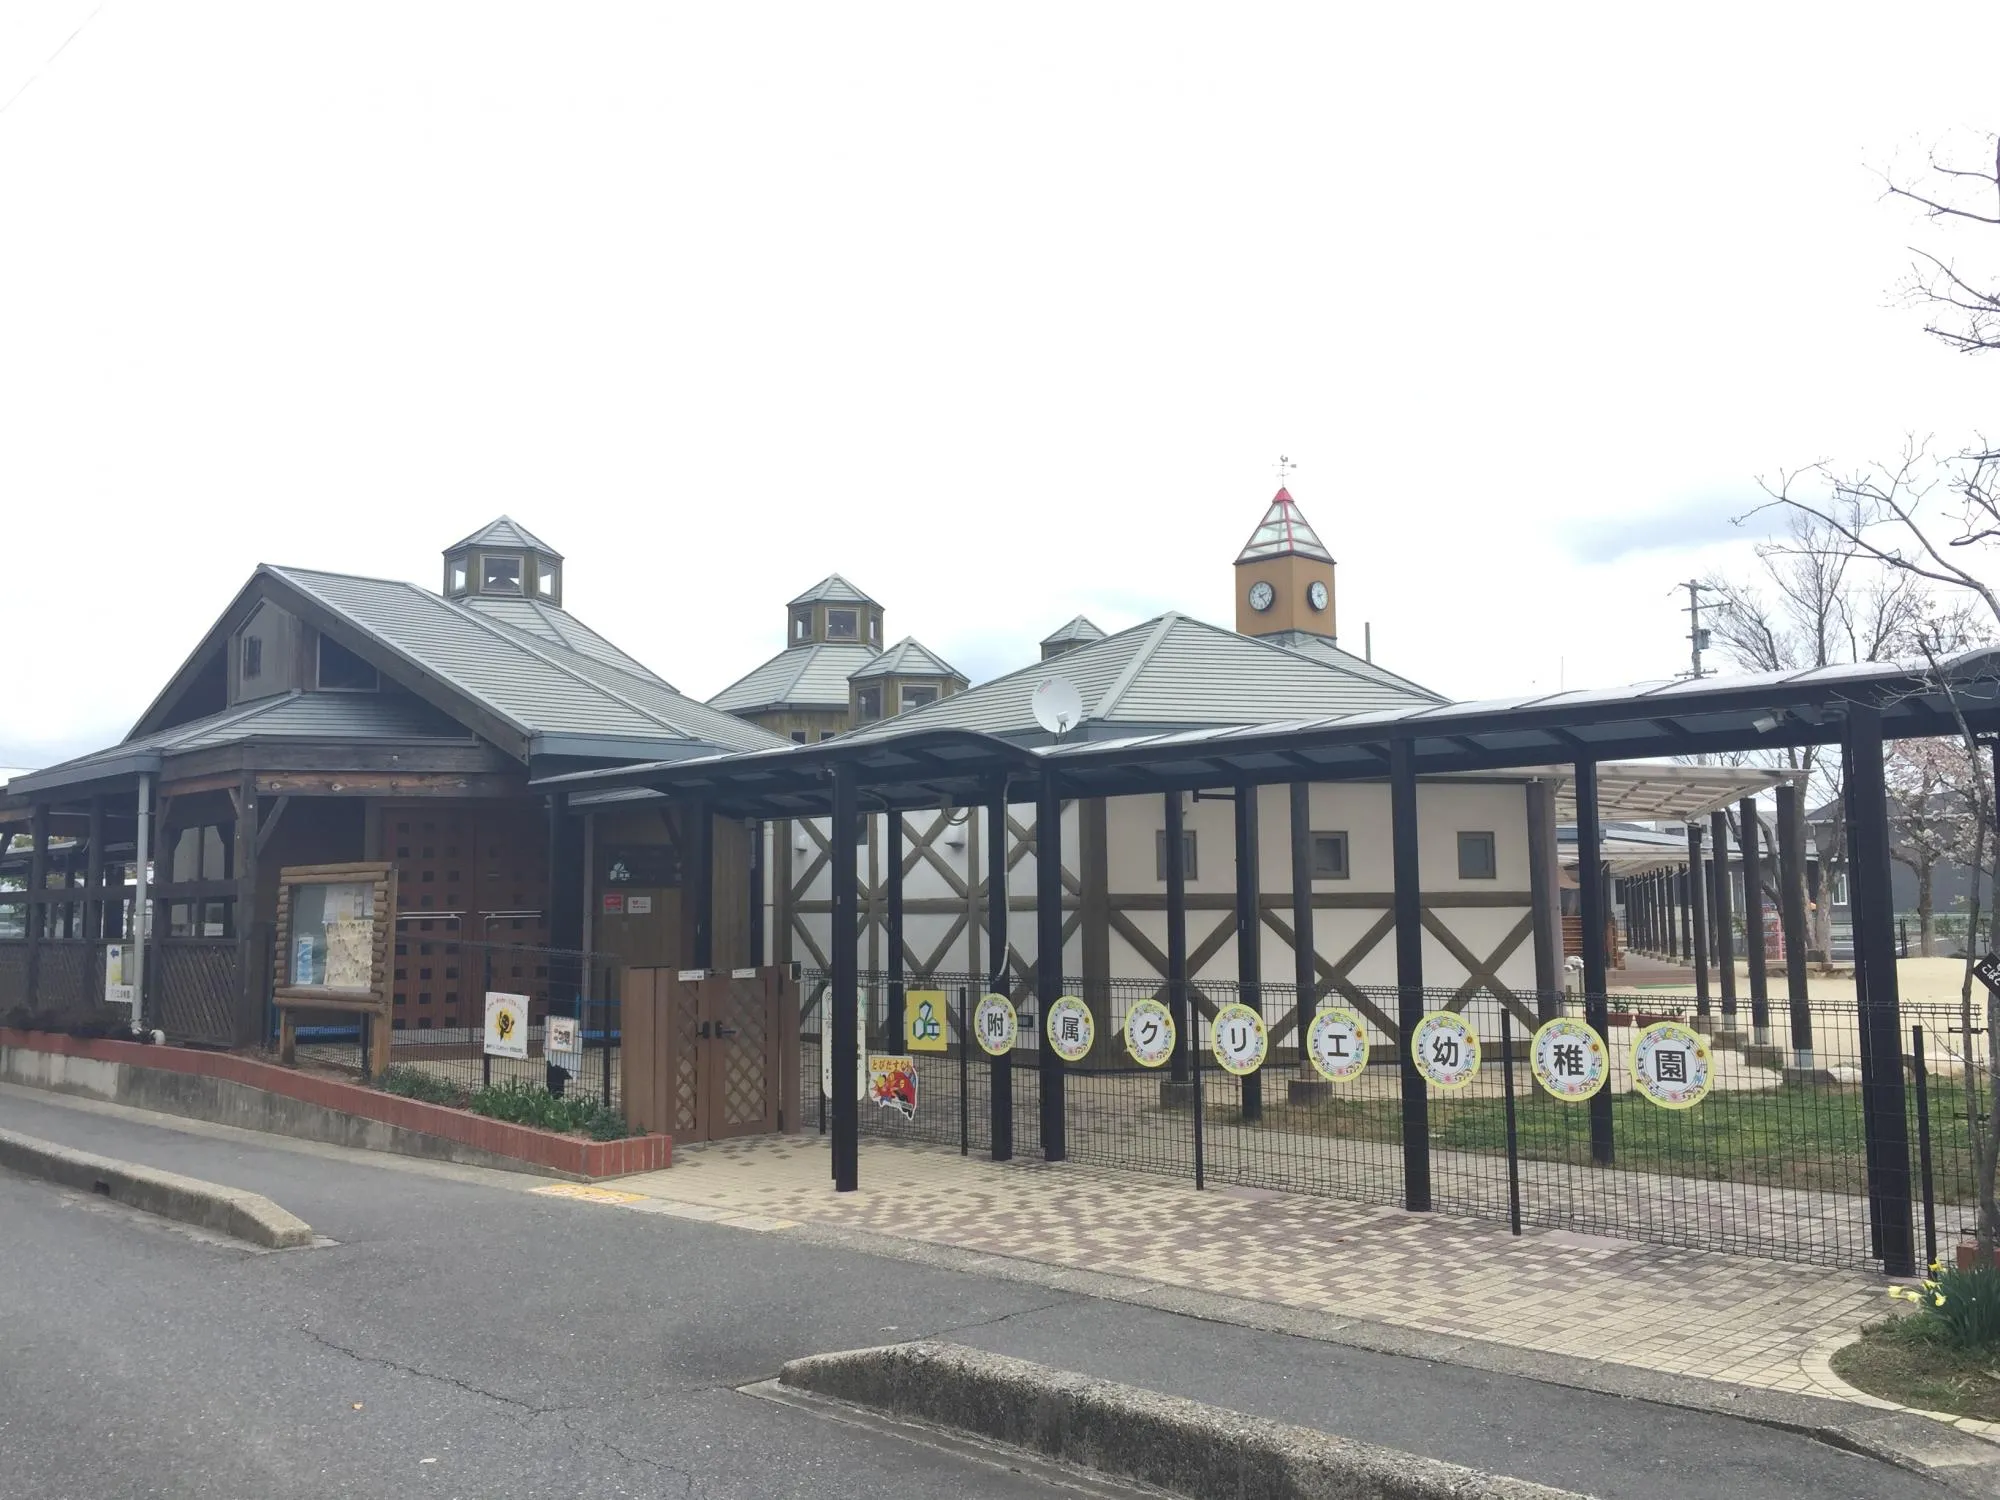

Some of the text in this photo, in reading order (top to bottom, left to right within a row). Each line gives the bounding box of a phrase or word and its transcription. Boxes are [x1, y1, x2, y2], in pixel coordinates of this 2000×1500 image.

[987, 1013, 1004, 1037] 附
[1061, 1016, 1080, 1042] 属
[1140, 1021, 1159, 1046] ク
[1231, 1028, 1247, 1053] リ
[1432, 1036, 1458, 1067] 幼
[1553, 1044, 1585, 1077] 稚
[1655, 1050, 1688, 1084] 園
